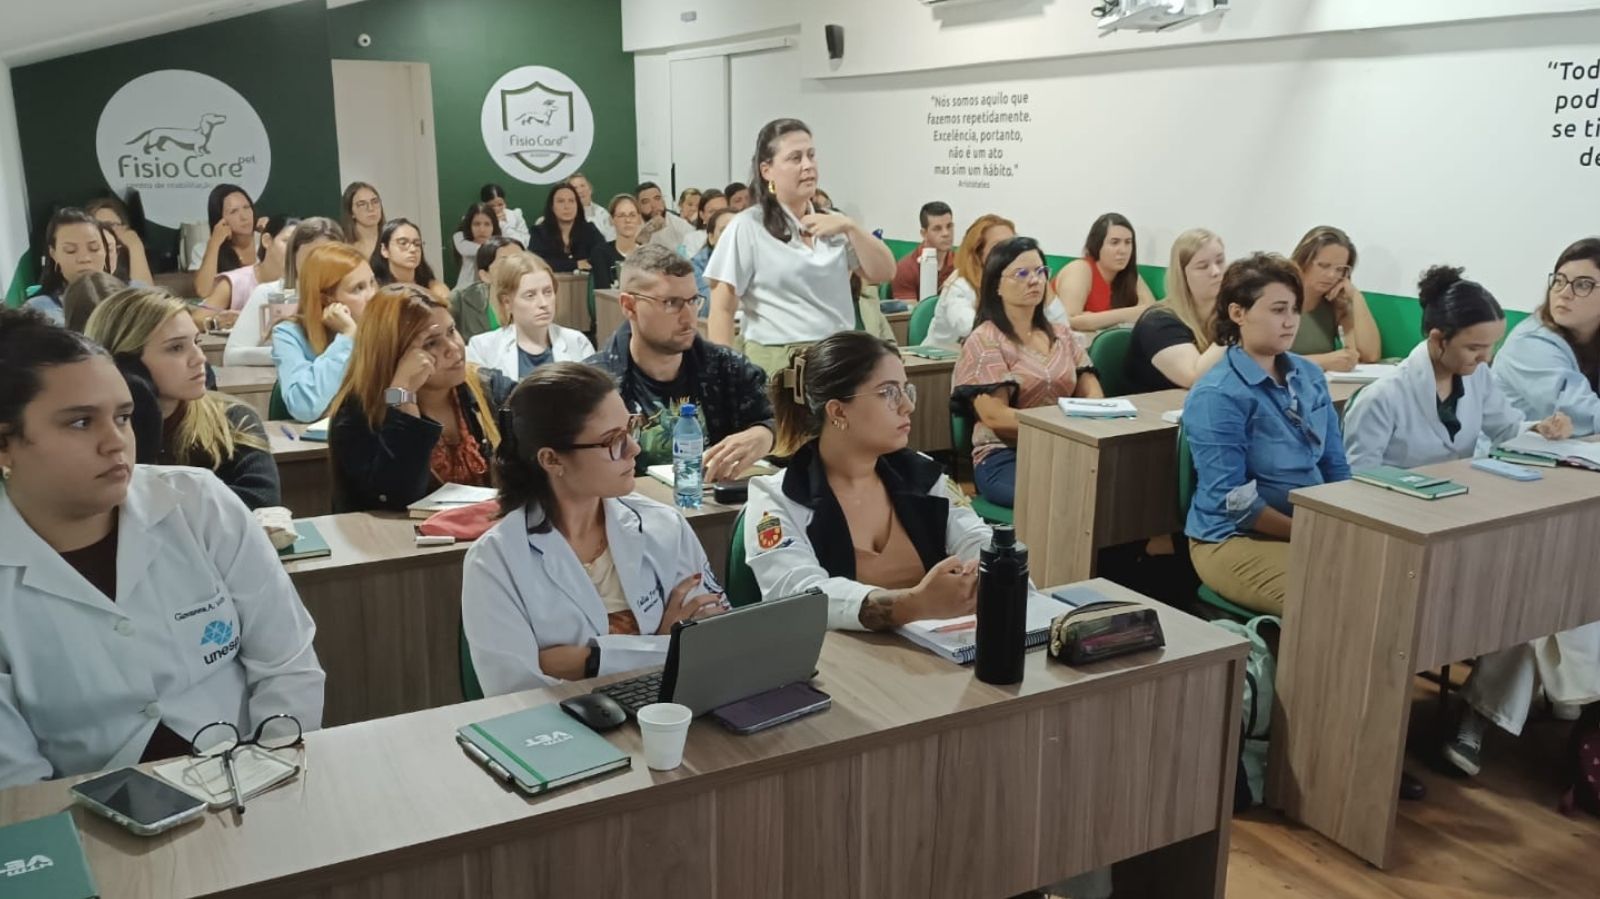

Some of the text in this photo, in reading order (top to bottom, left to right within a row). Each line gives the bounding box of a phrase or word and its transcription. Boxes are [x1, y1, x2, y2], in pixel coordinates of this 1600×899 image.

[952, 96, 979, 107] somos
[981, 92, 1008, 107] aquilo
[1011, 93, 1029, 106] que
[1555, 88, 1599, 114] pod
[927, 112, 960, 125] fazemos
[980, 129, 1023, 143] portanto,
[1552, 123, 1576, 138] se
[509, 134, 535, 147] Fisio
[948, 145, 1003, 159] não é um ato
[118, 155, 256, 178] Fisio Care pet
[934, 166, 950, 175] mas
[952, 163, 966, 175] sim
[968, 166, 980, 176] um
